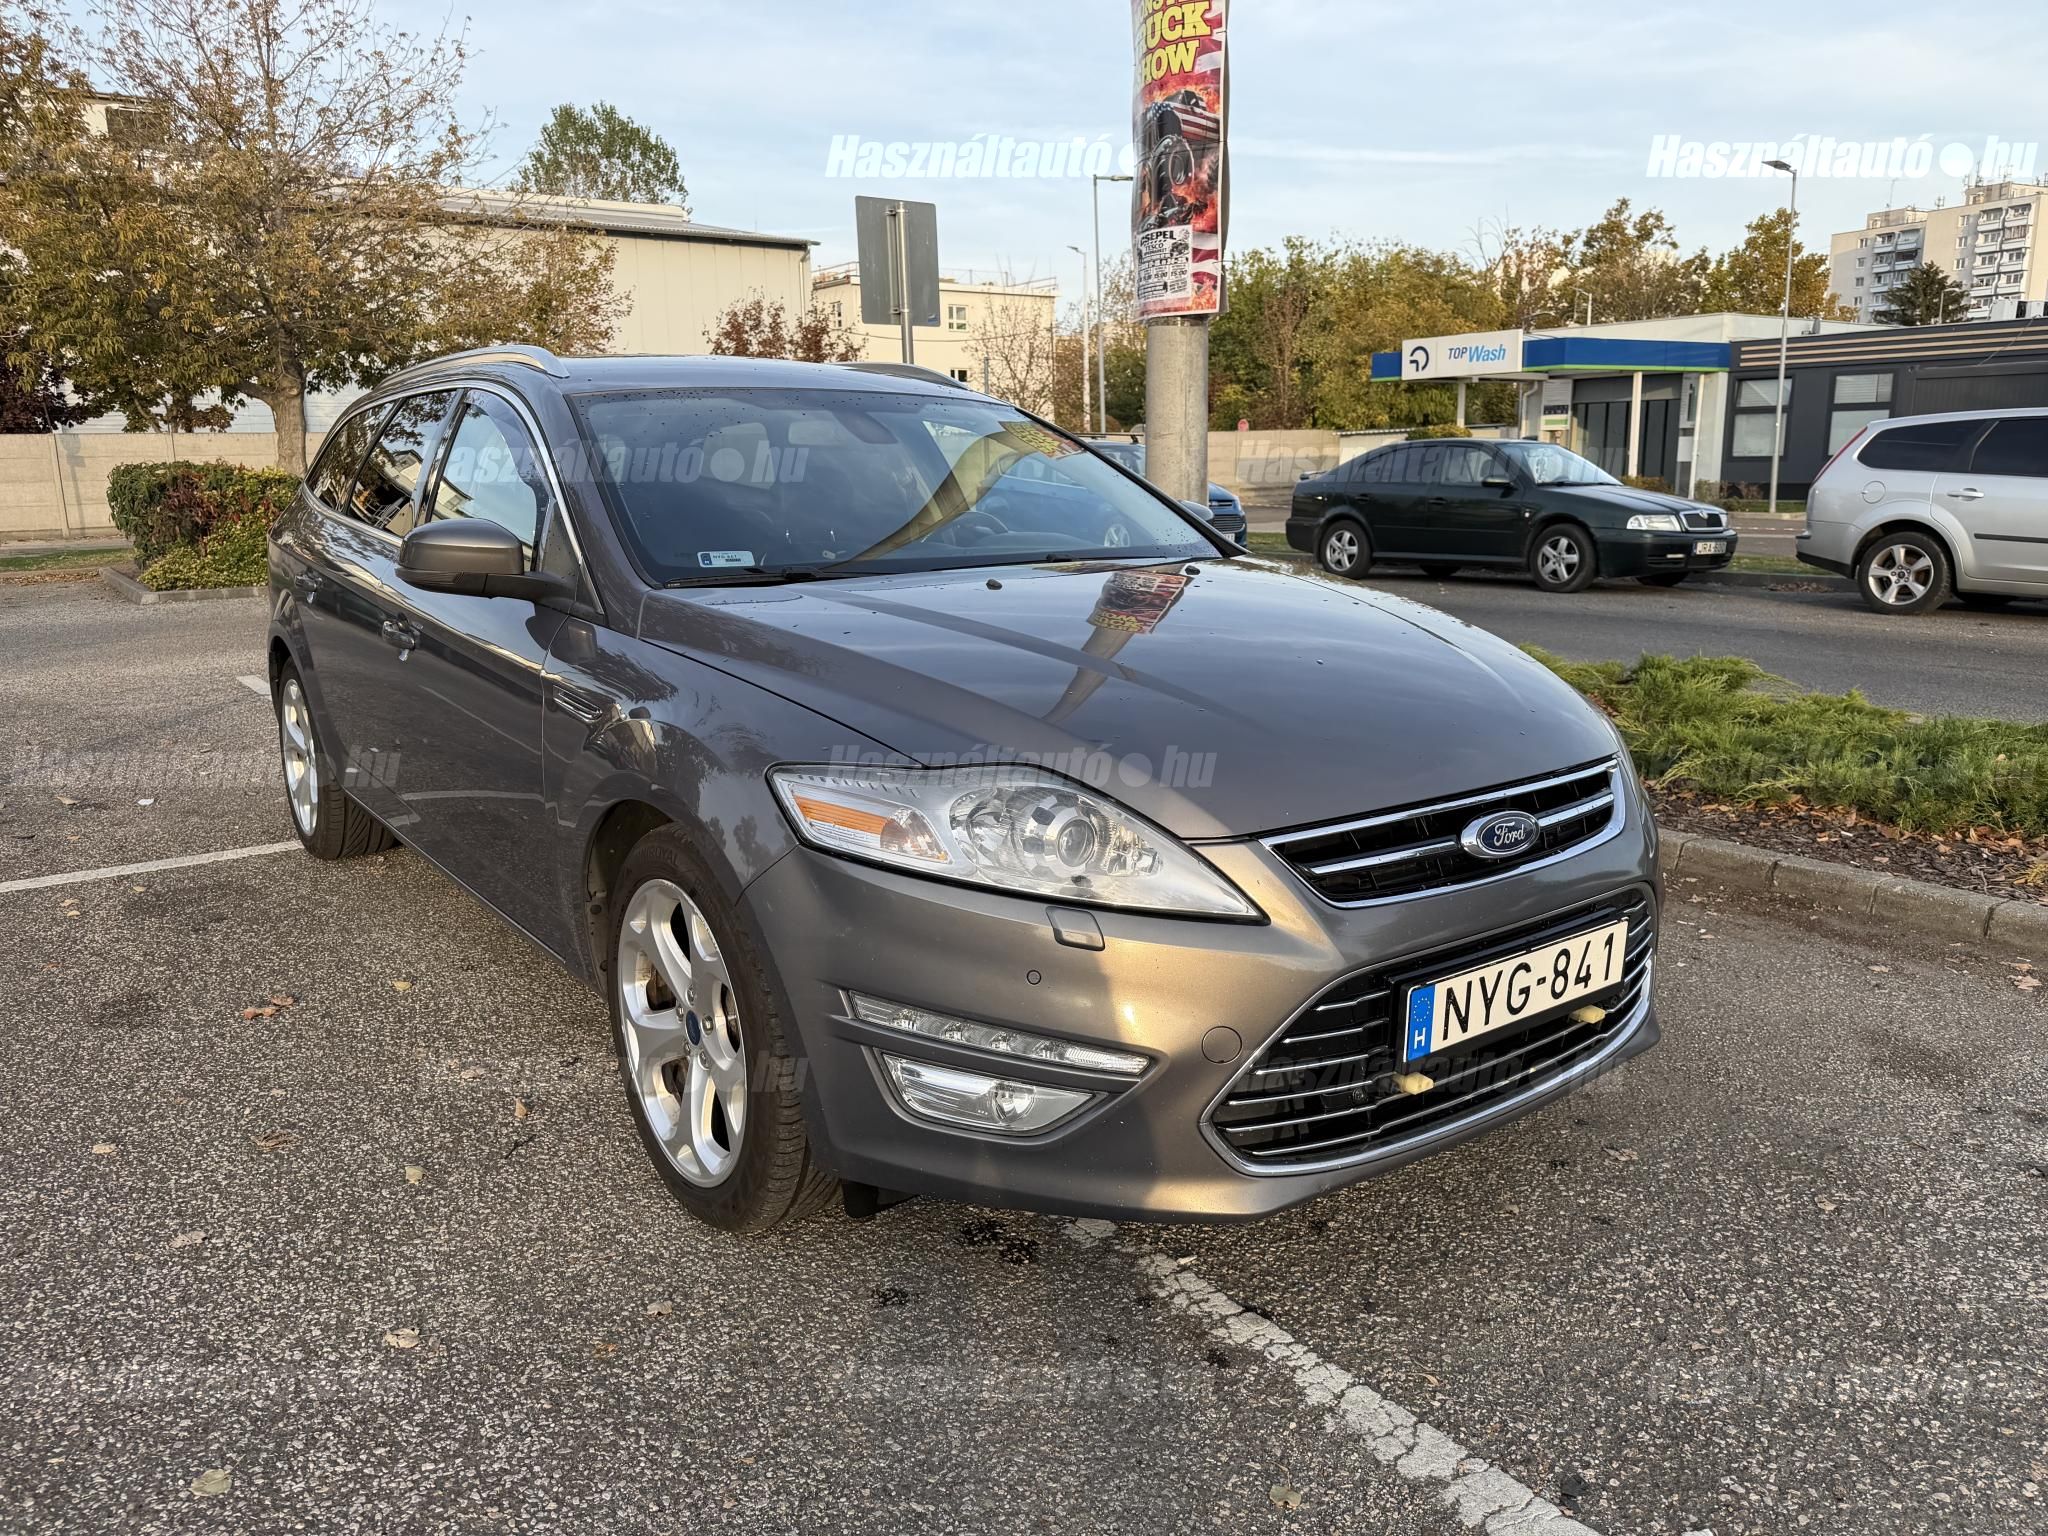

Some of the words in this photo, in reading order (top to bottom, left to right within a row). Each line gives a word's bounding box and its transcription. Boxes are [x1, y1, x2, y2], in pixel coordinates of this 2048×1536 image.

[1494, 821, 1526, 847] Ford
[1442, 932, 1615, 1041] NYG-841
[1414, 1027, 1426, 1049] H
